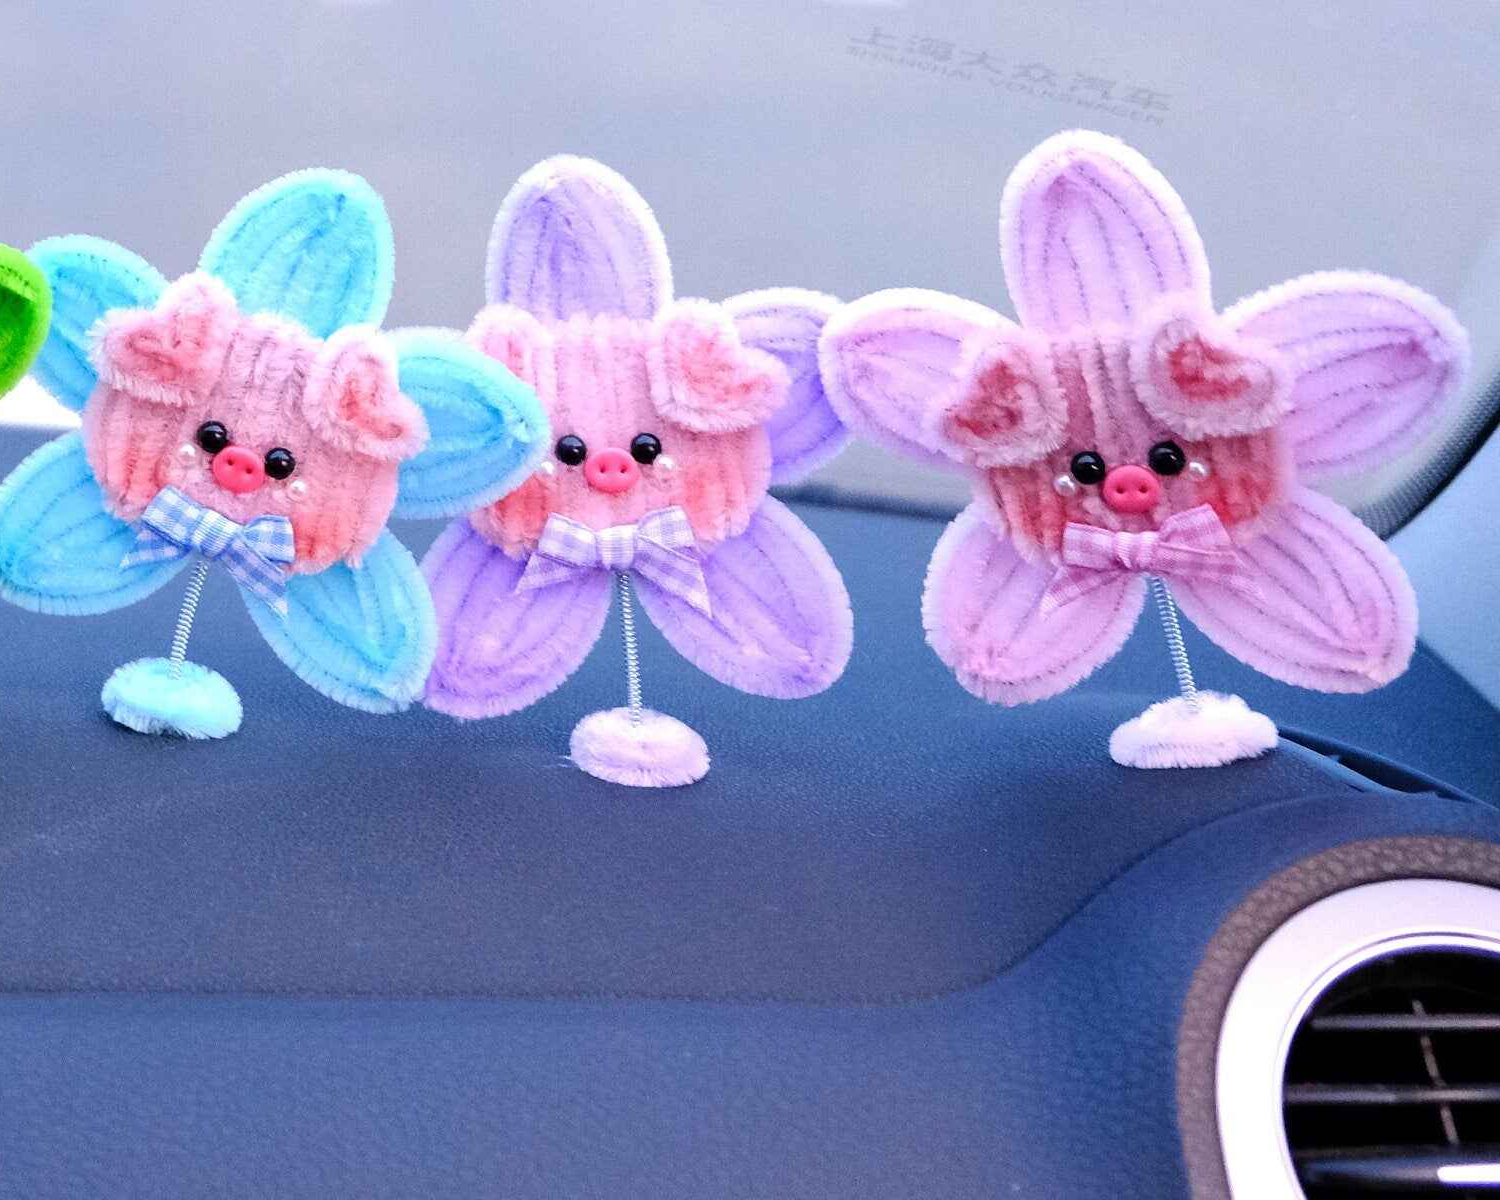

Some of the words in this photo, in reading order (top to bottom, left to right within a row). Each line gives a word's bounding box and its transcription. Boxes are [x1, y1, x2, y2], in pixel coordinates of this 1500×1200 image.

[847, 26, 1172, 112] 上海大众汽车
